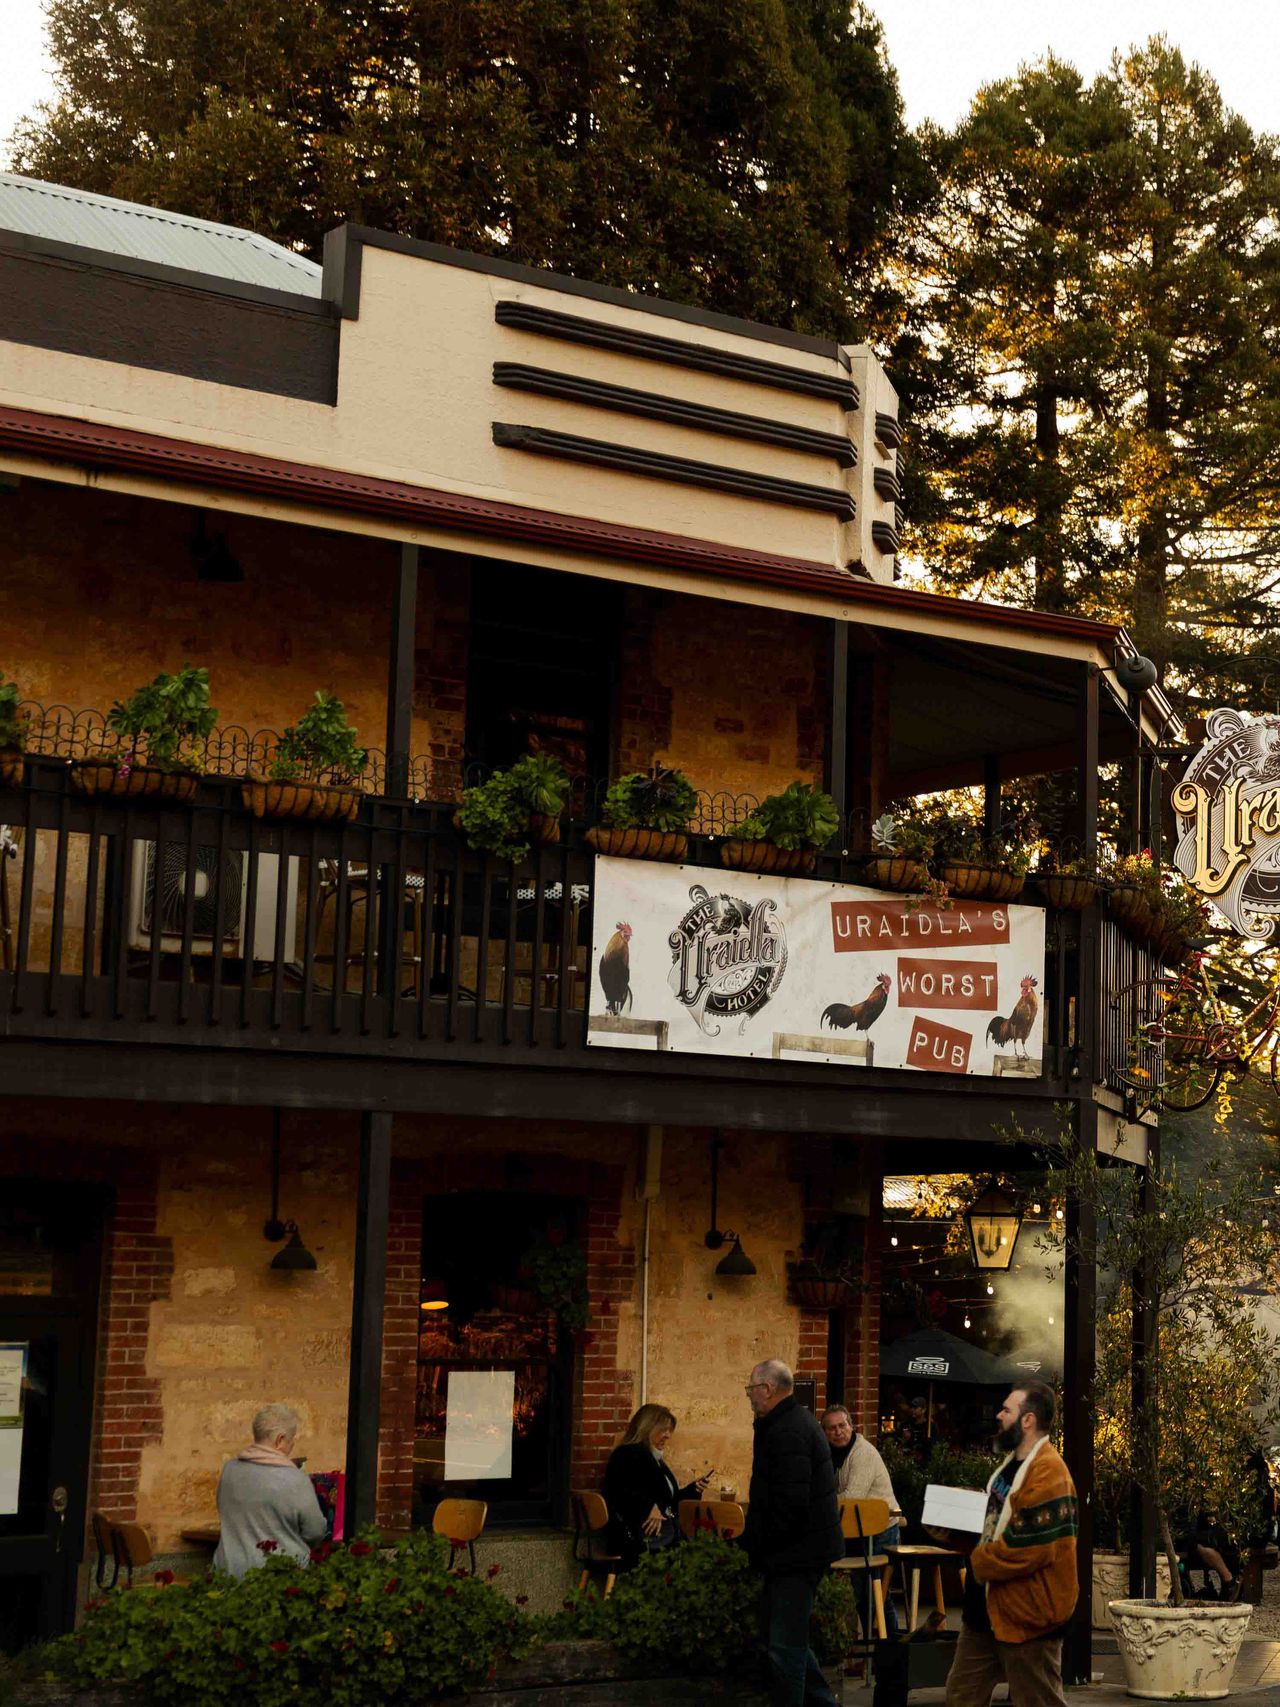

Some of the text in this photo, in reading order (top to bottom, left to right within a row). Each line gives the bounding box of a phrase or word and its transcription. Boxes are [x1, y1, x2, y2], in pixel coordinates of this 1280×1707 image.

[1203, 739, 1251, 781] THE
[686, 904, 714, 930] THE
[836, 910, 1006, 938] URAIDLA'S
[668, 898, 780, 1007] Uraidla
[727, 971, 769, 1010] HOTEL
[900, 971, 994, 997] WORST
[913, 1031, 965, 1067] PUB
